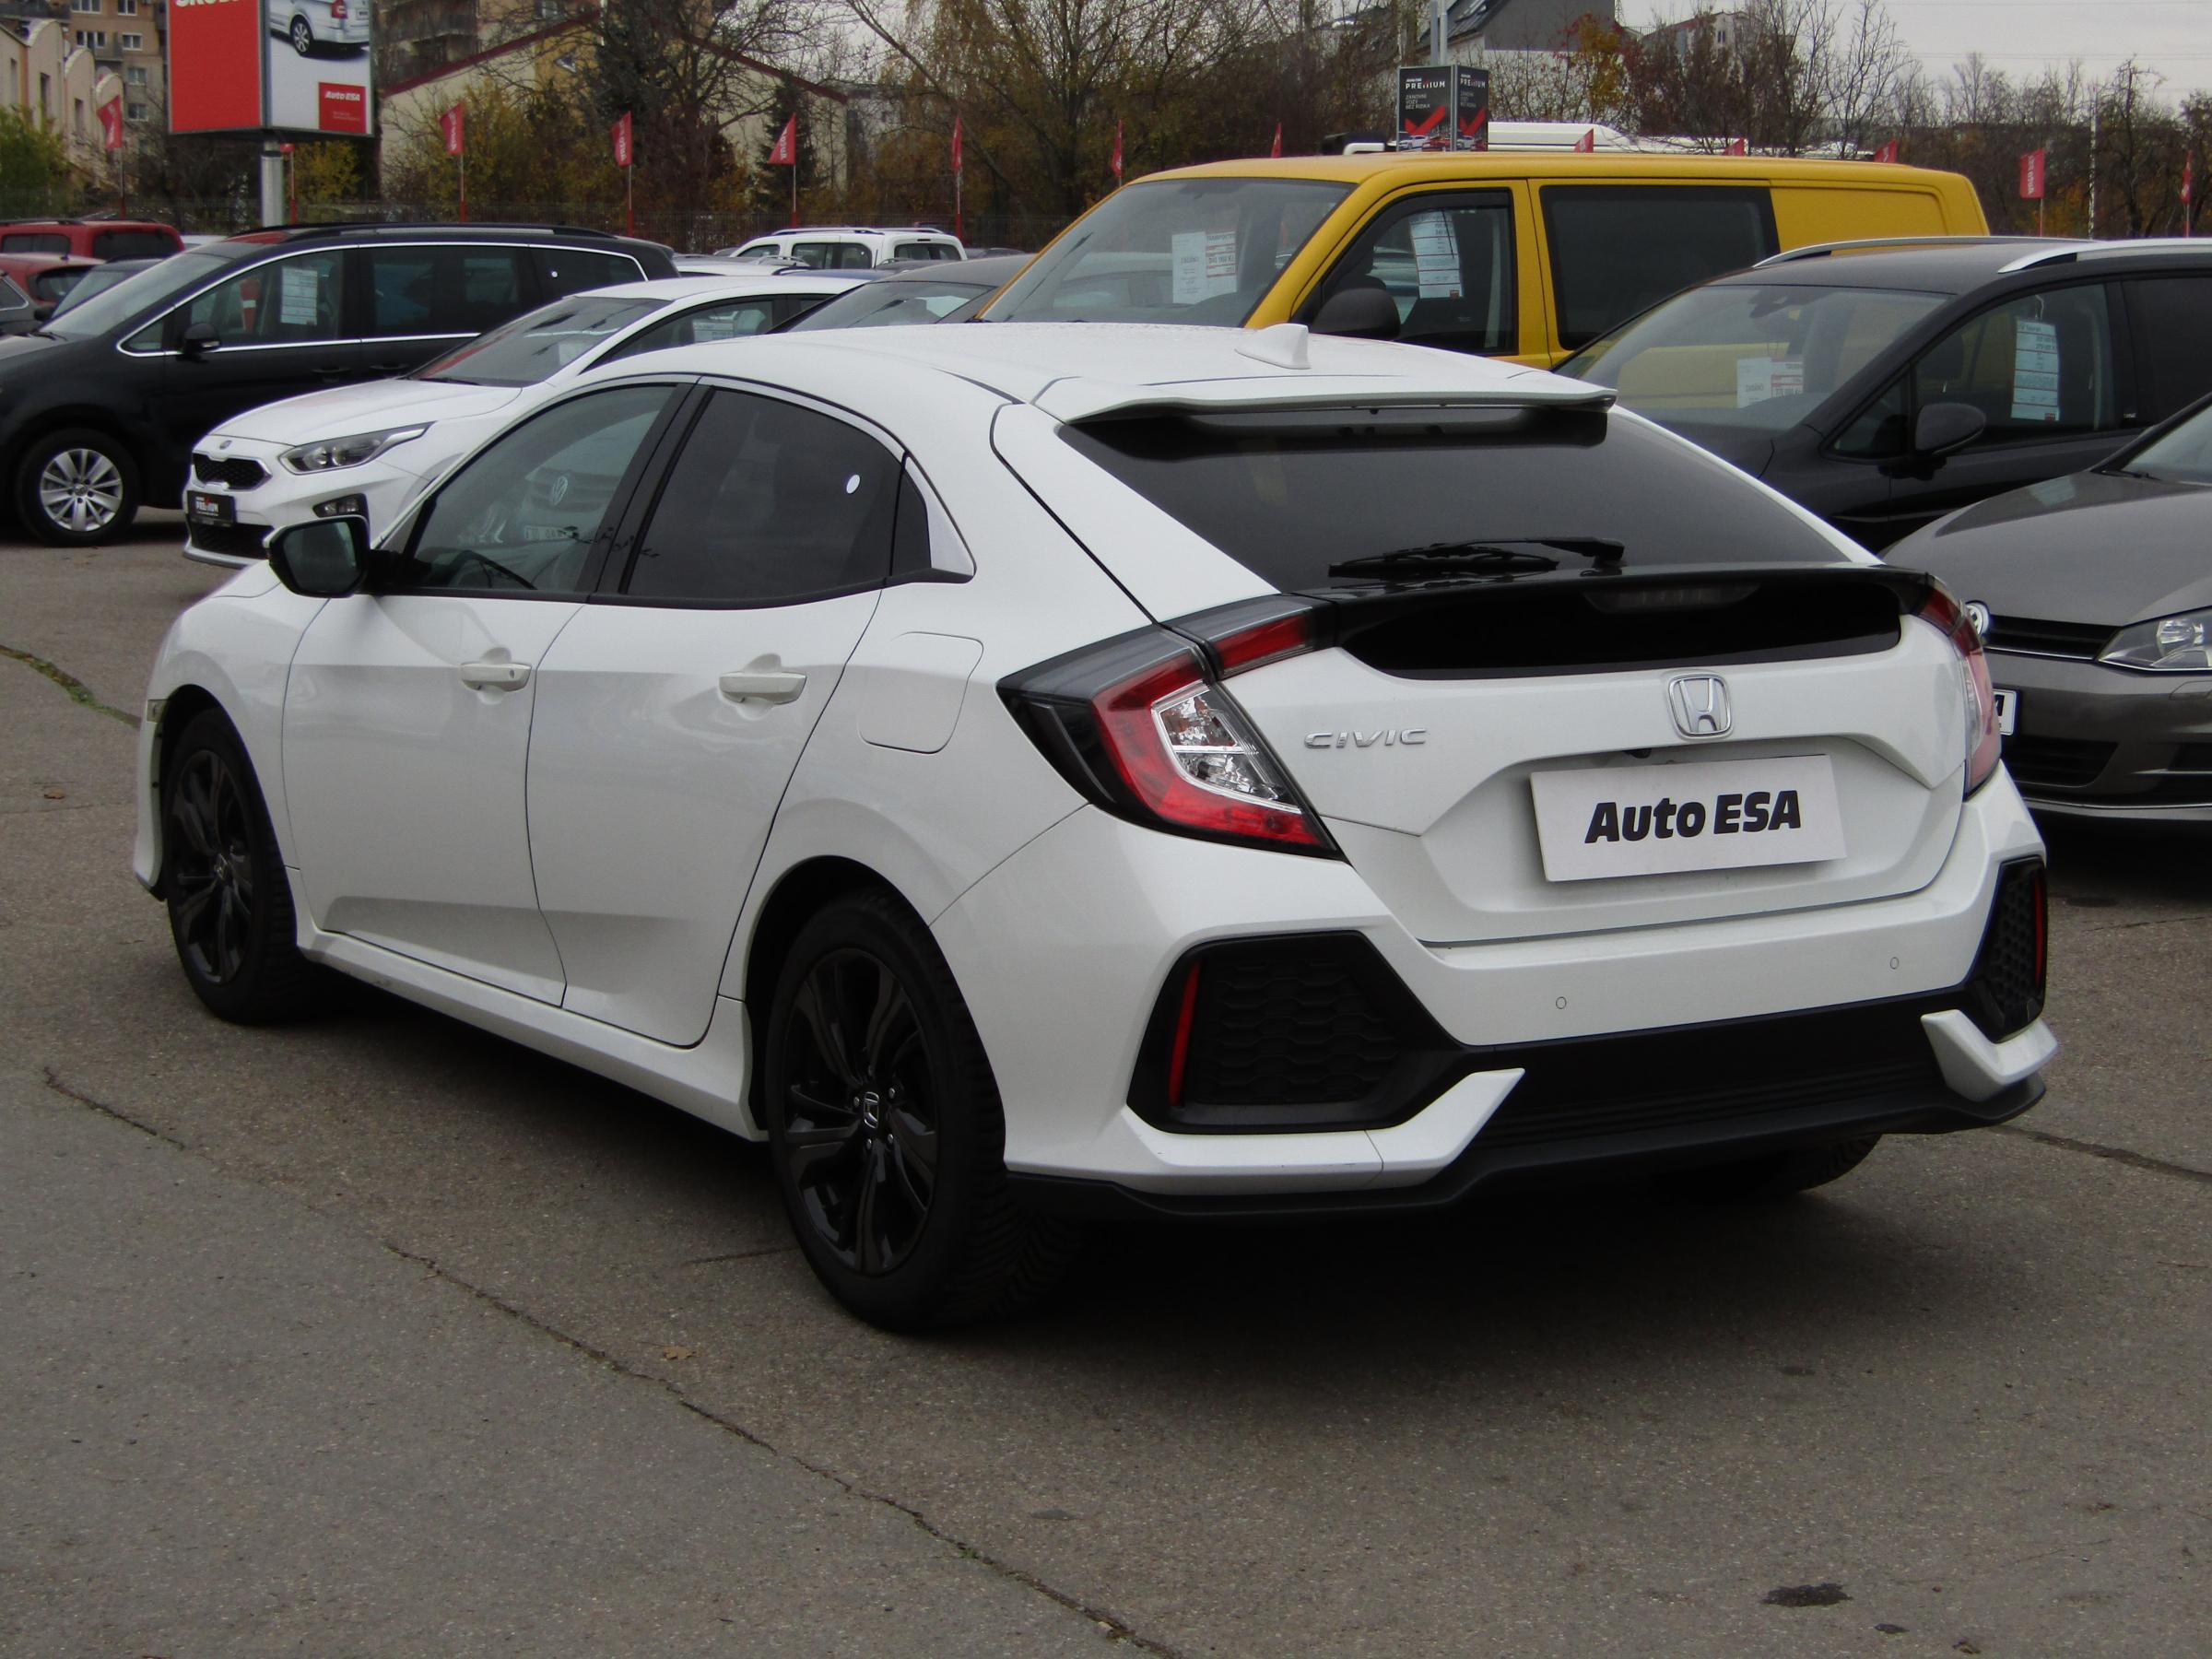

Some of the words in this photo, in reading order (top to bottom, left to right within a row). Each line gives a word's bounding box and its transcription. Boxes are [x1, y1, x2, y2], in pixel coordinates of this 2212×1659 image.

[1304, 728, 1427, 748] CIVIC
[1584, 798, 1706, 844] Auto
[1713, 790, 1801, 834] ESA
